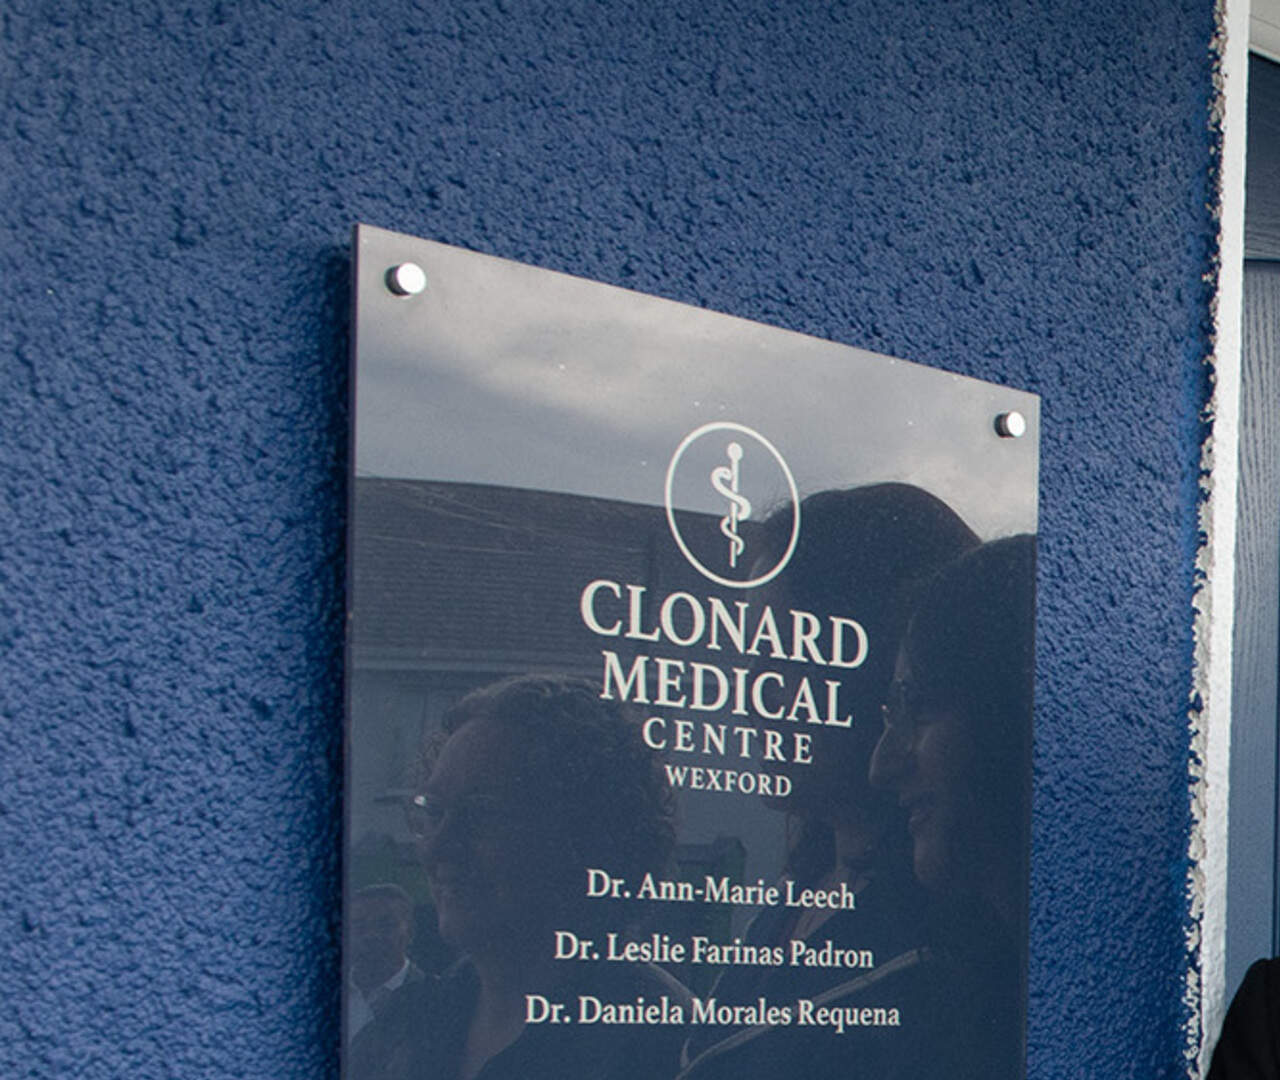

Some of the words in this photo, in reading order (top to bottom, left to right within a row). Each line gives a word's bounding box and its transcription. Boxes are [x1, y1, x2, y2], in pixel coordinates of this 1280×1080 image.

[580, 579, 869, 669] CLONARD
[599, 650, 853, 728] MEDICAL
[642, 716, 813, 764] CENTRE
[664, 764, 792, 797] WEXFORD
[586, 868, 631, 899] Dr.
[636, 872, 780, 906] Ann-Marie
[785, 880, 855, 910] Leech
[554, 931, 600, 961] Dr.
[607, 933, 686, 963] Leslie
[691, 936, 784, 966] Farinas
[790, 939, 874, 968] Padron
[525, 994, 571, 1024] Dr.
[578, 995, 685, 1025] Daniela
[690, 997, 792, 1026] Morales
[797, 999, 900, 1034] Requena
